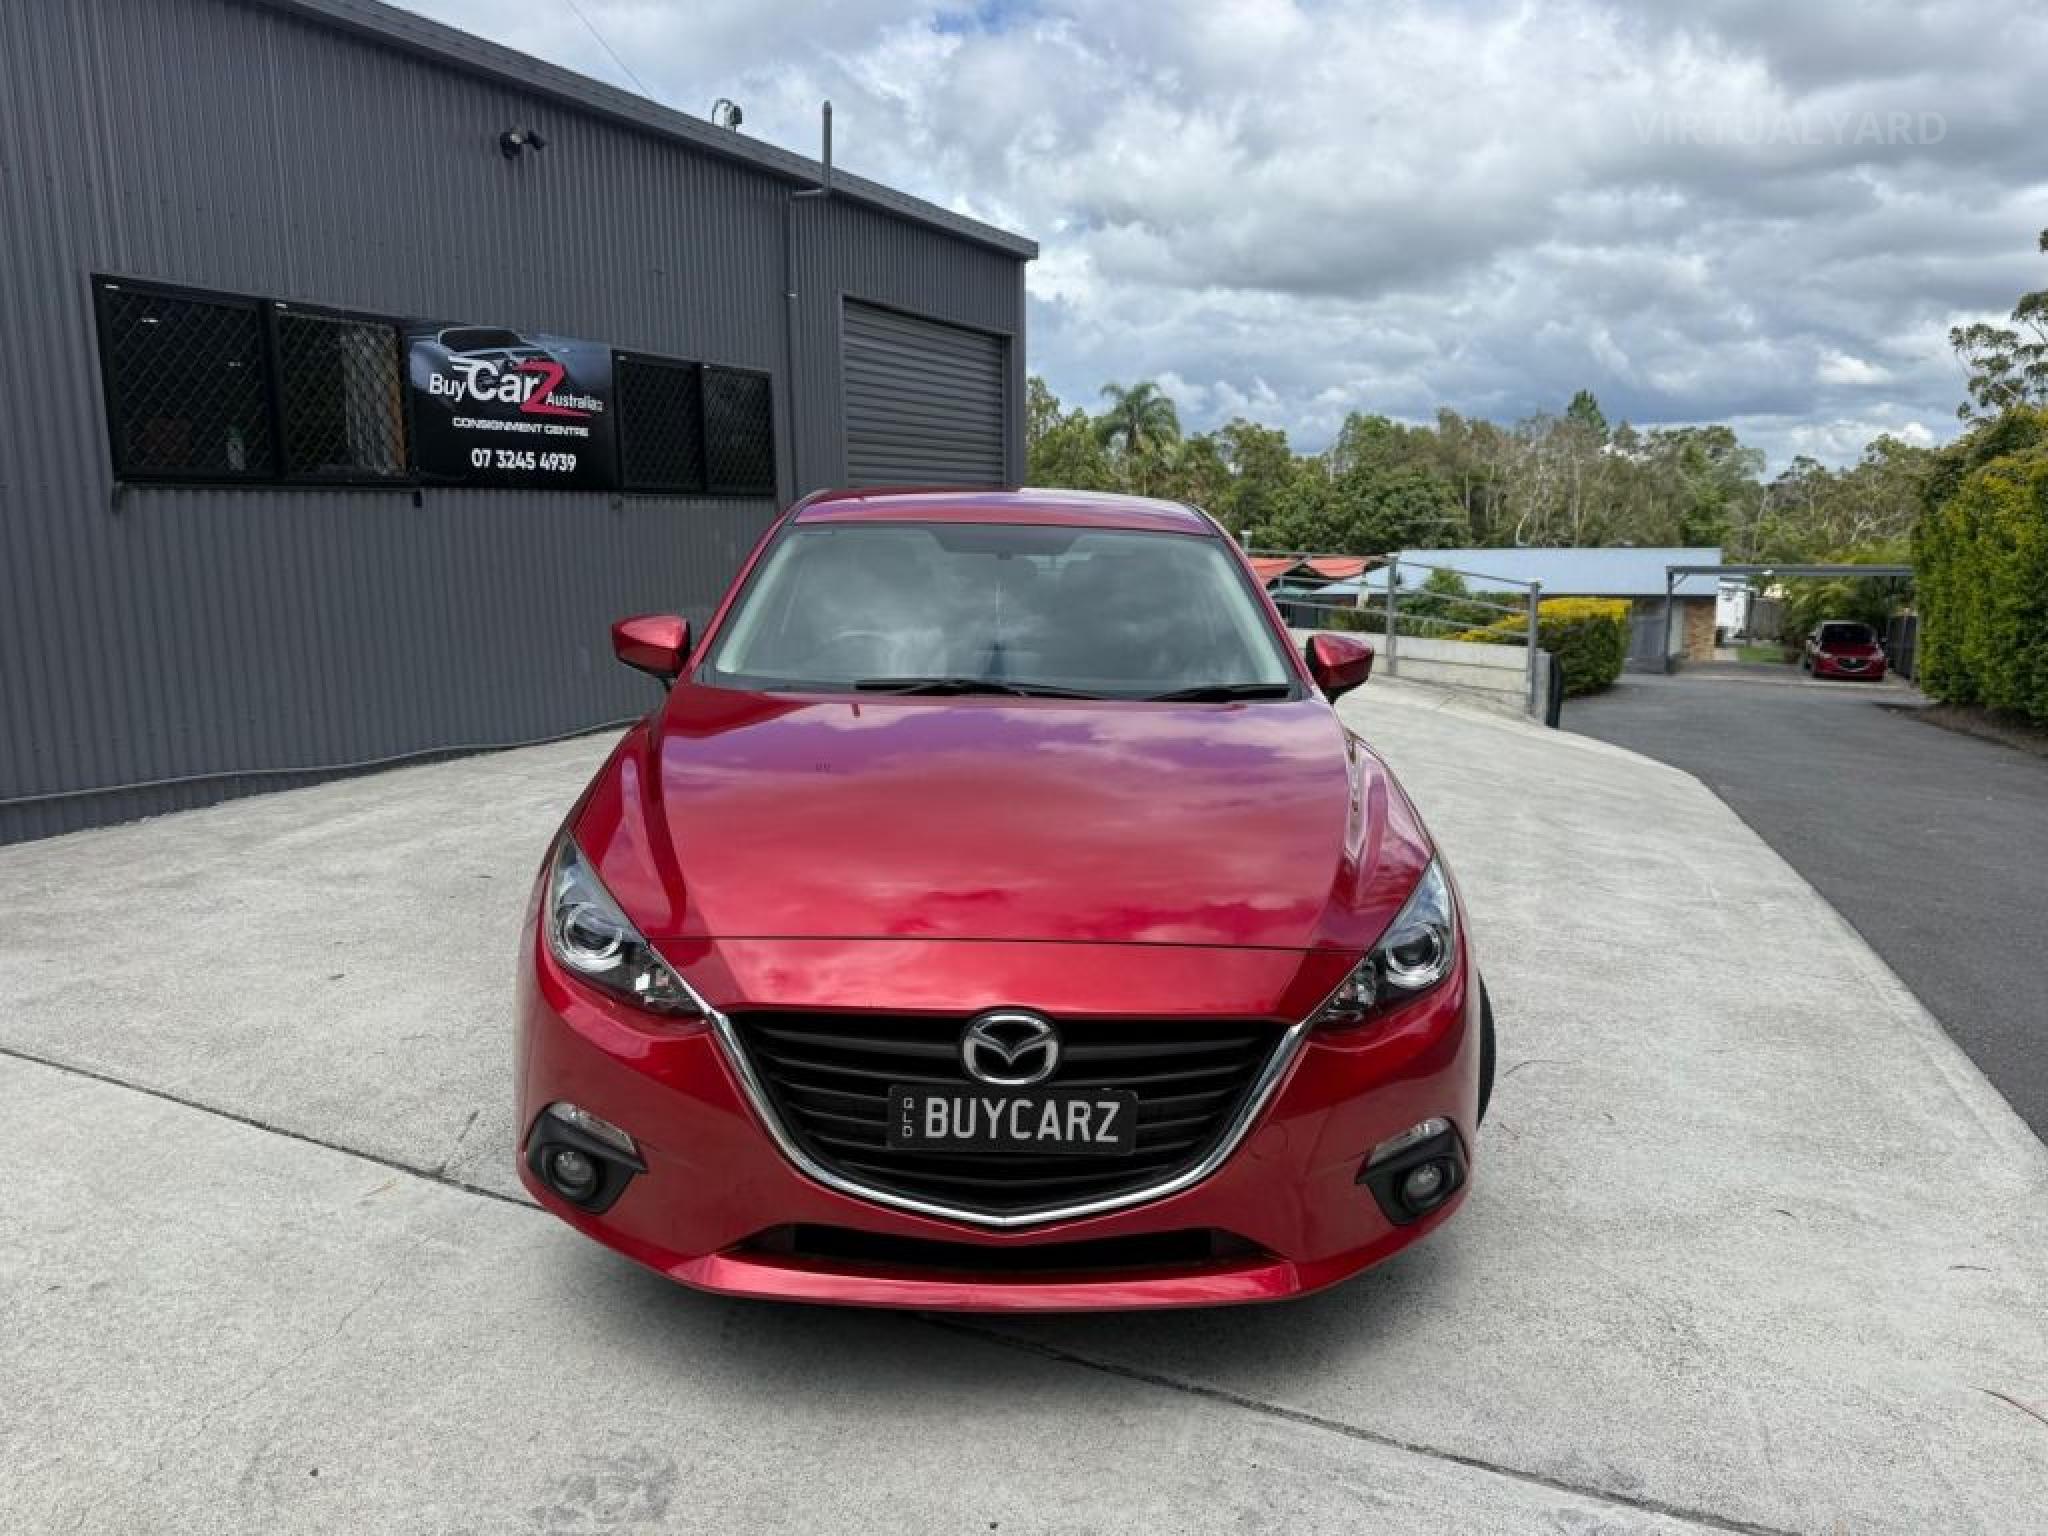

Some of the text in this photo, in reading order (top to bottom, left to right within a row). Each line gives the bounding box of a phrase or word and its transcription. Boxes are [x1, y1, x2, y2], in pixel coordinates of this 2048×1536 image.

[452, 416, 589, 437] CONSIGNMENT CENTRE
[471, 447, 577, 472] 07 3245 4939
[925, 1097, 1121, 1142] BUYCARZ
